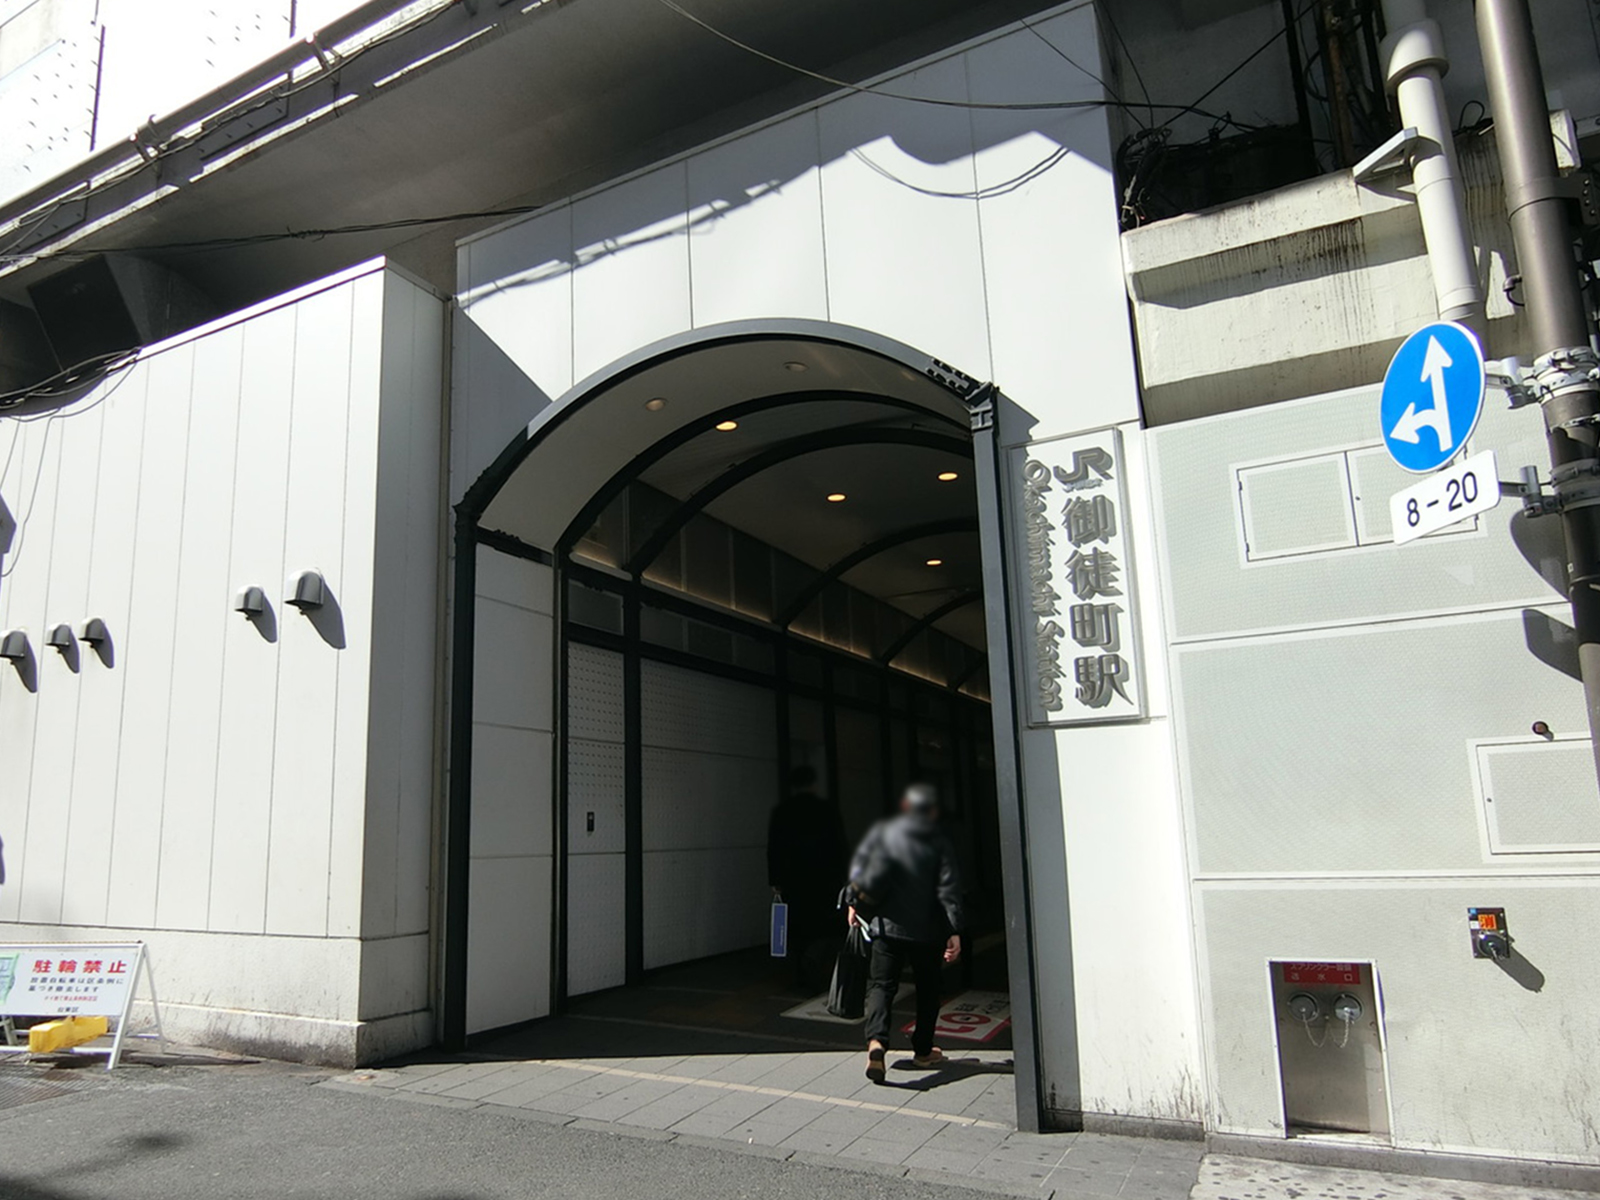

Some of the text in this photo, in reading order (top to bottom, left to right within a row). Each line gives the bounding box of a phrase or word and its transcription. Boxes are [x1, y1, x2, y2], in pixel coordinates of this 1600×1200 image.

[1406, 471, 1479, 528] 8-20
[1023, 459, 1067, 711] Okachimachi Station
[33, 960, 127, 973] 駐輪禁止
